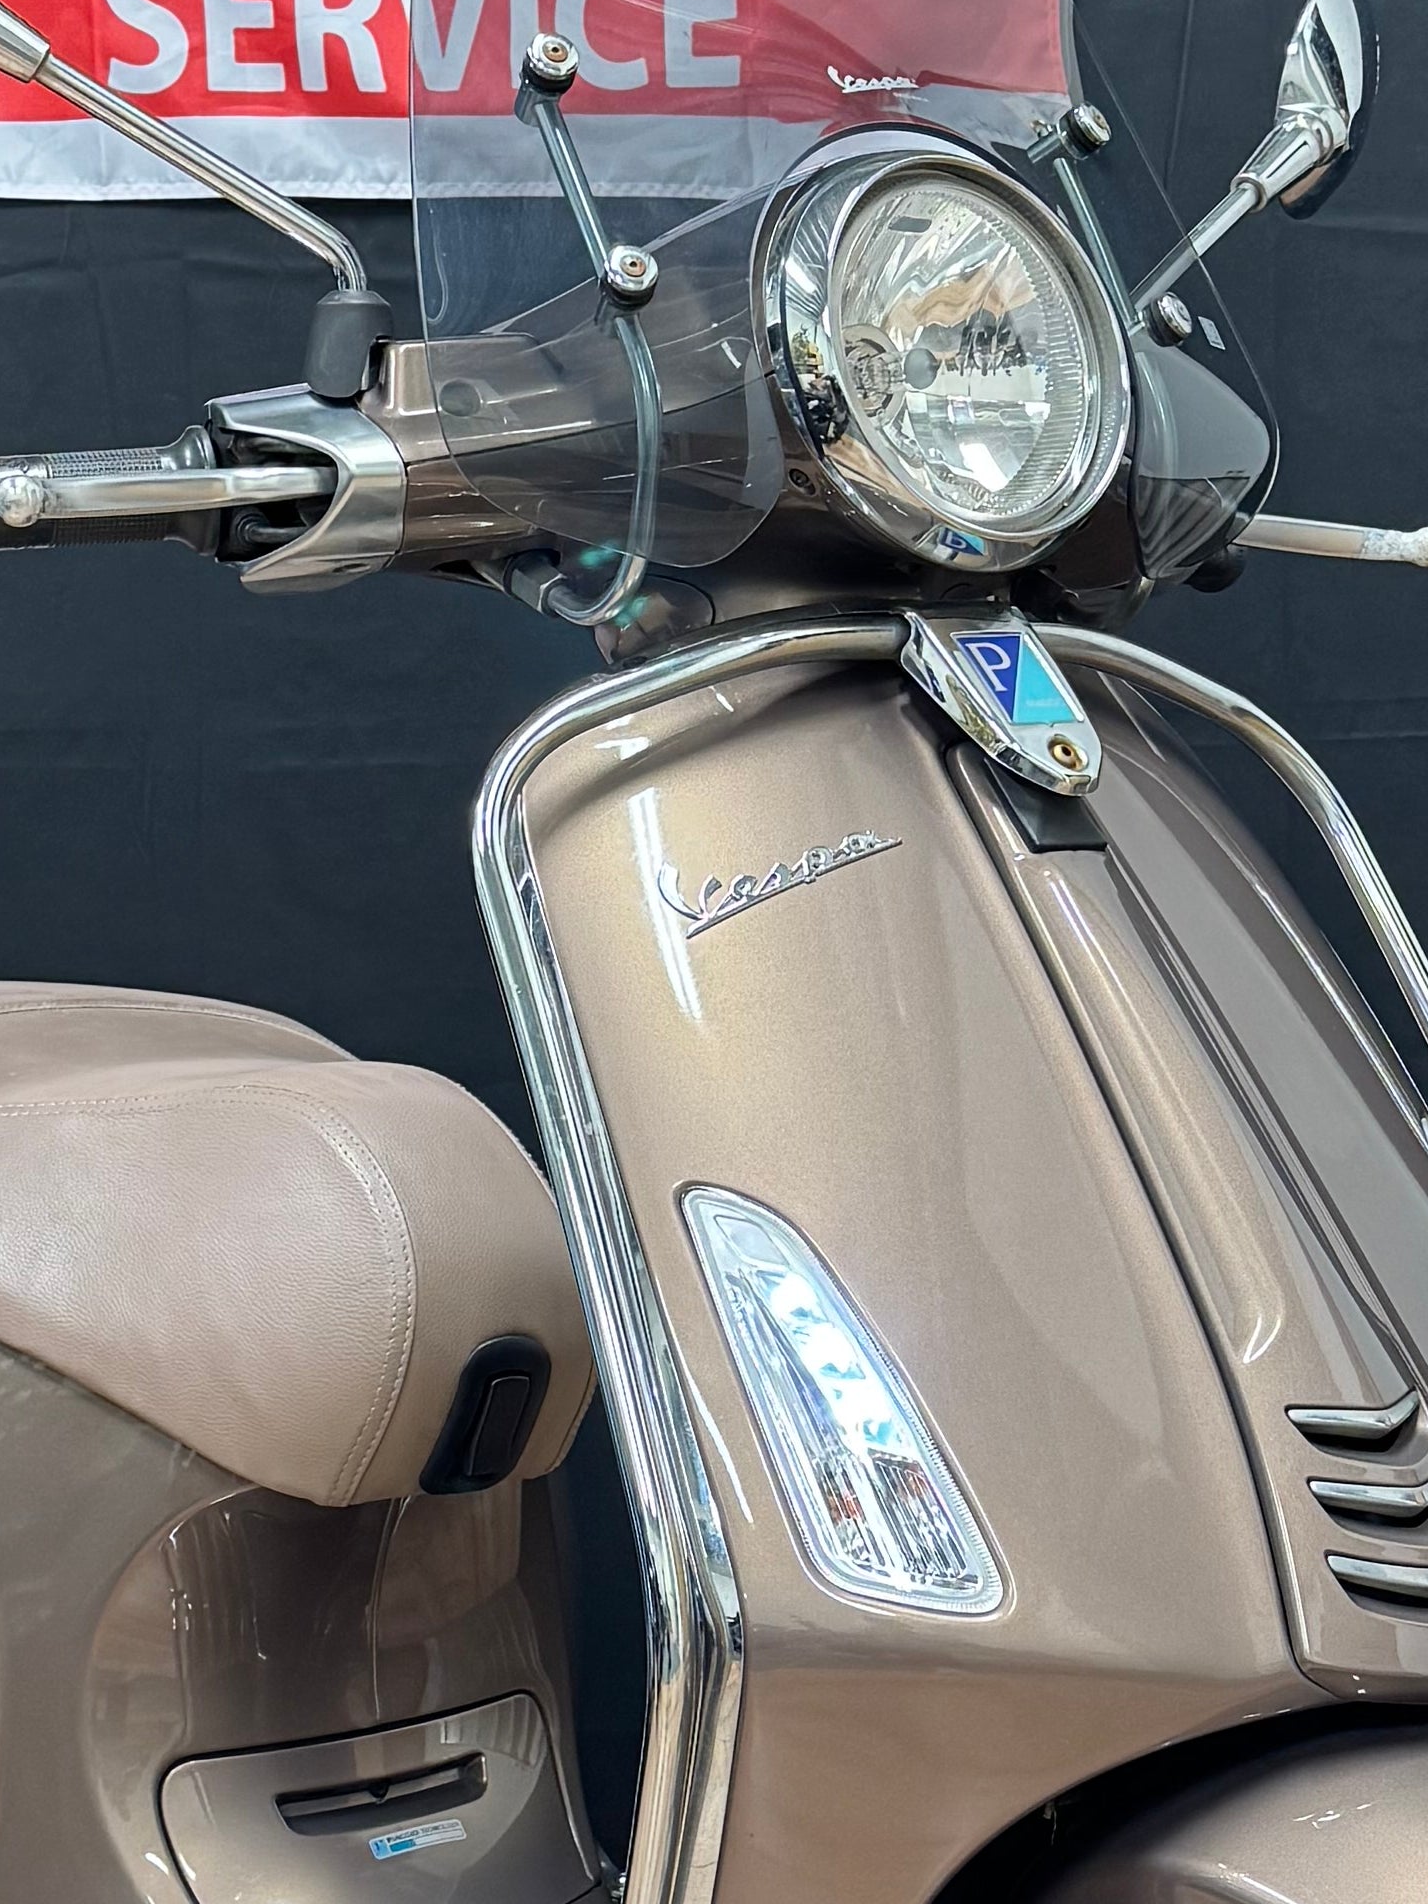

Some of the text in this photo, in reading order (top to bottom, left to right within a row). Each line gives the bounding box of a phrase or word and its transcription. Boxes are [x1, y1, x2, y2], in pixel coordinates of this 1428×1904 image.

[827, 65, 919, 94] Vespa
[965, 642, 1012, 692] P
[657, 830, 903, 939] Vespa
